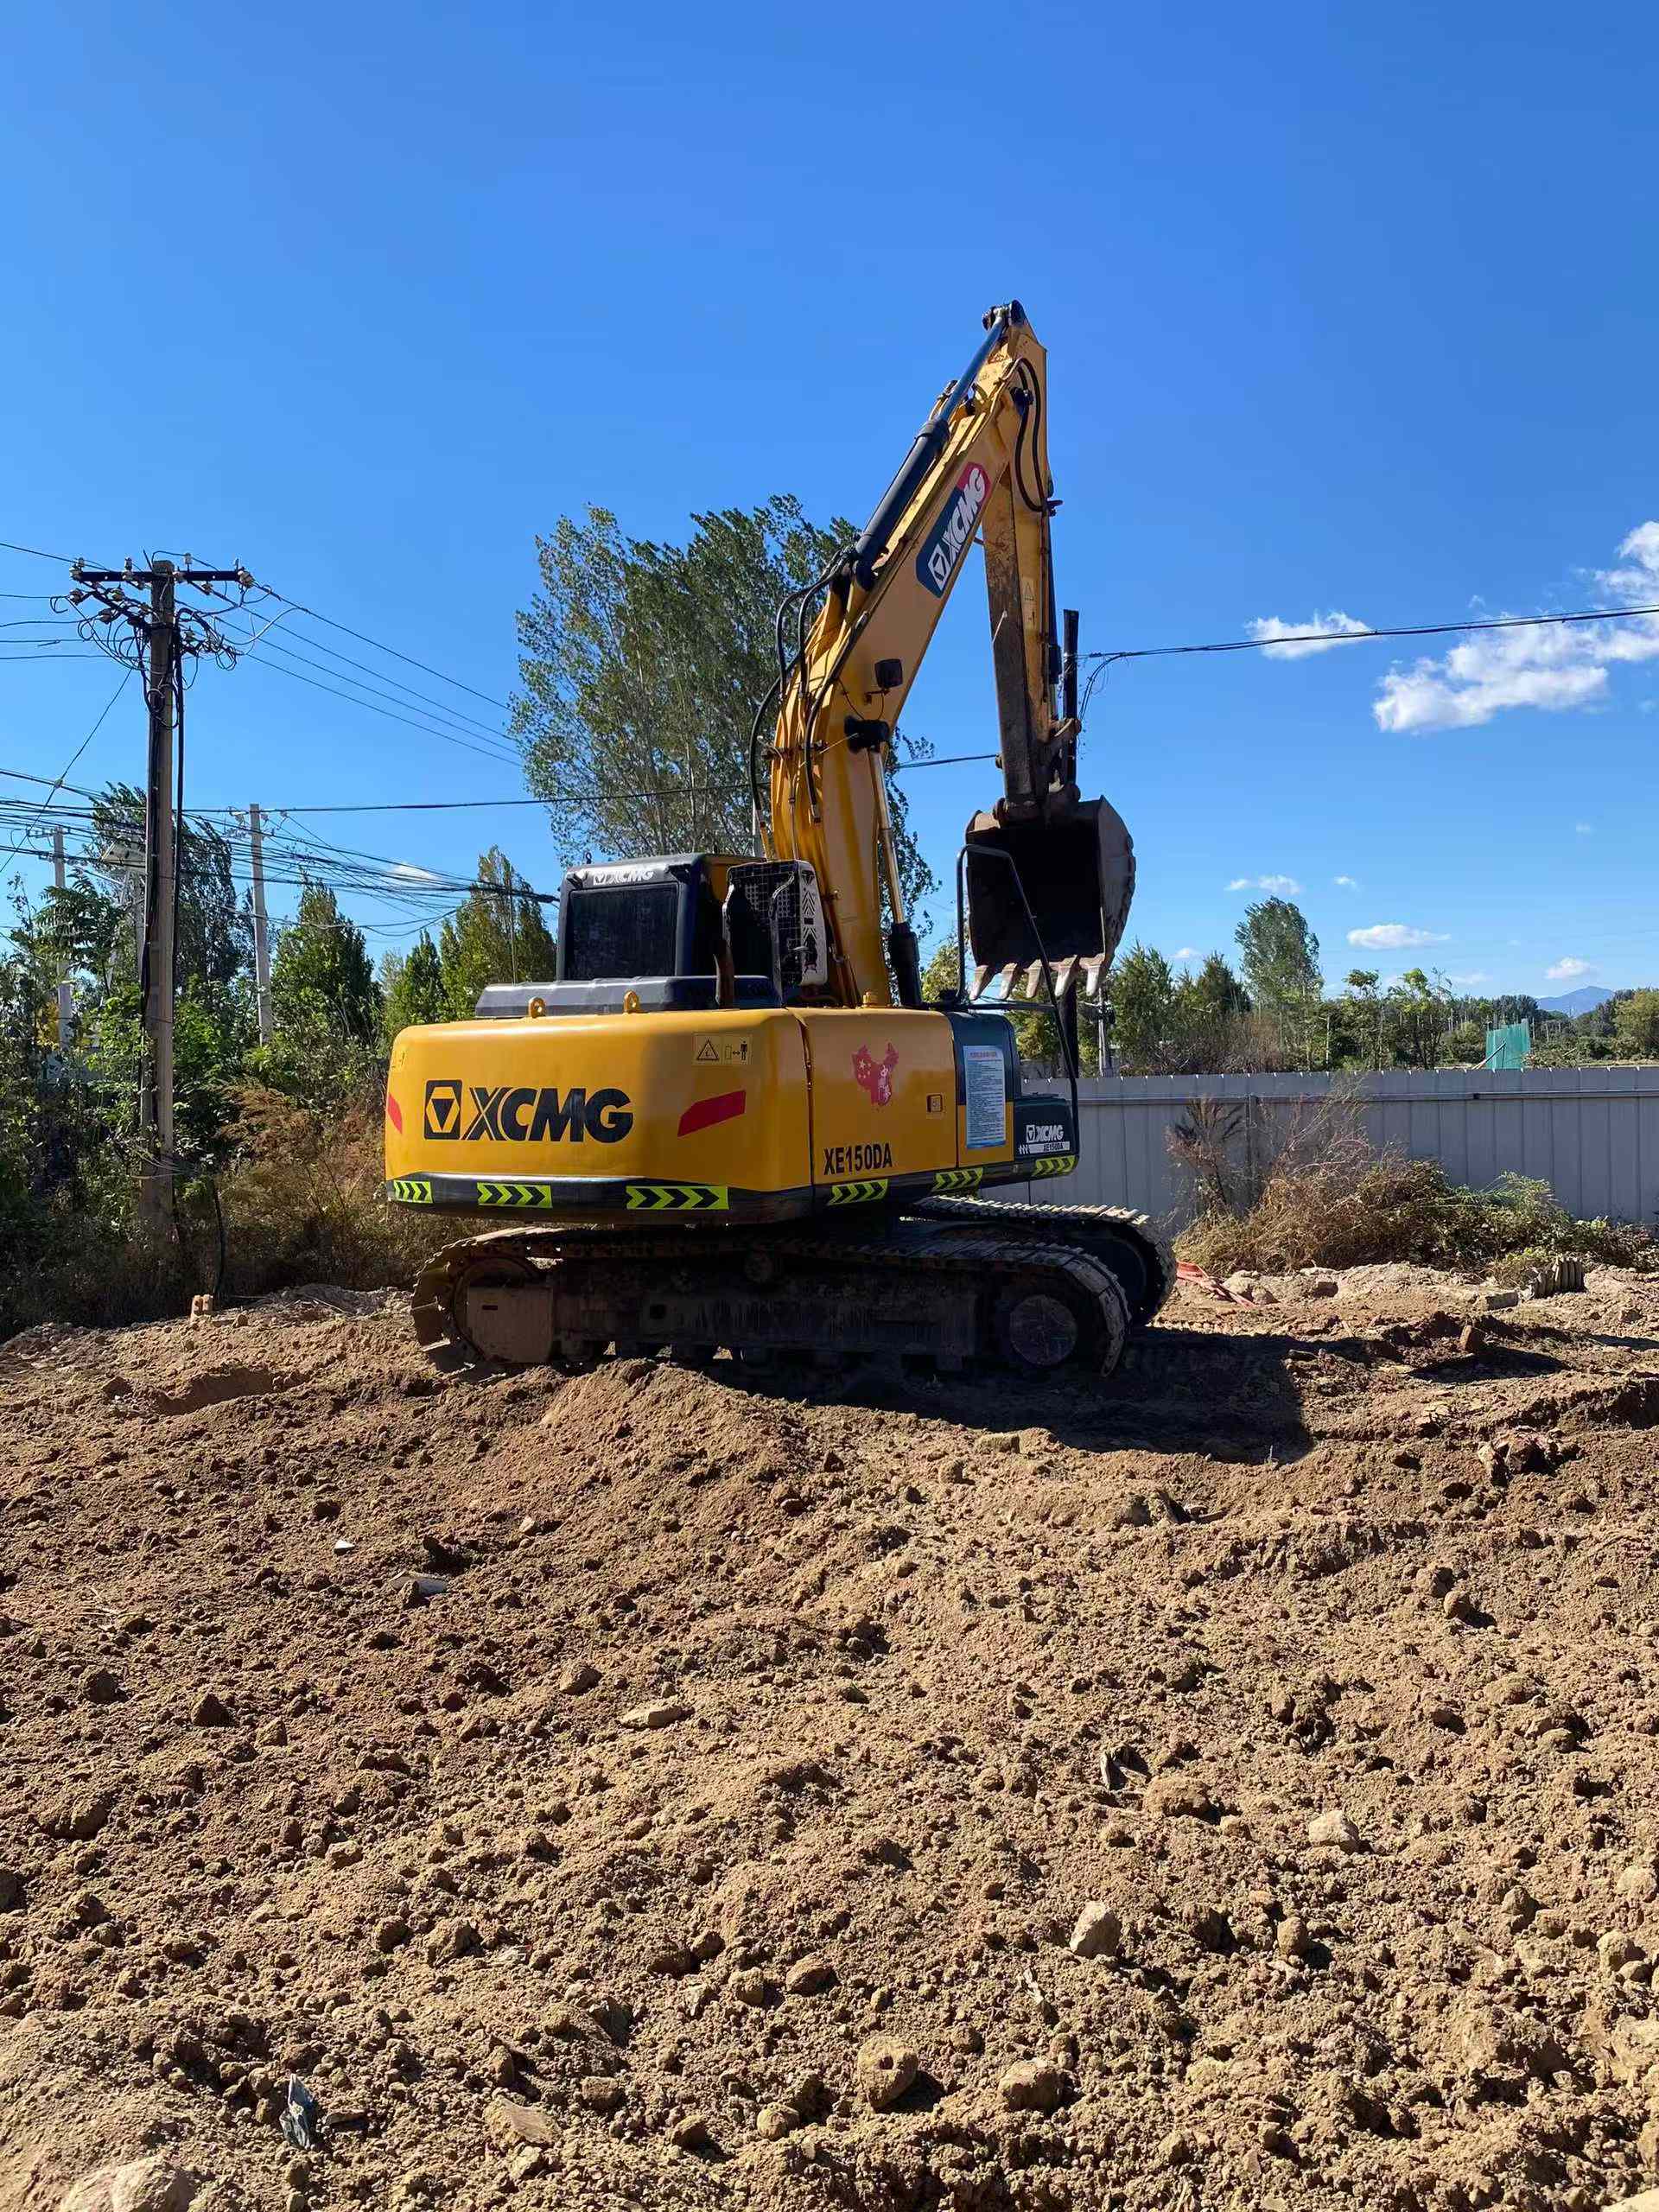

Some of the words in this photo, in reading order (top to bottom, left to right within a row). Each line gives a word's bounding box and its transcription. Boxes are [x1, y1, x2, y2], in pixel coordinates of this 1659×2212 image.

[942, 467, 986, 568] XCMG
[606, 869, 655, 885] XCMG
[460, 1086, 634, 1143] XCMG
[1036, 1124, 1065, 1141] XCMG
[823, 1142, 893, 1176] XE150DA
